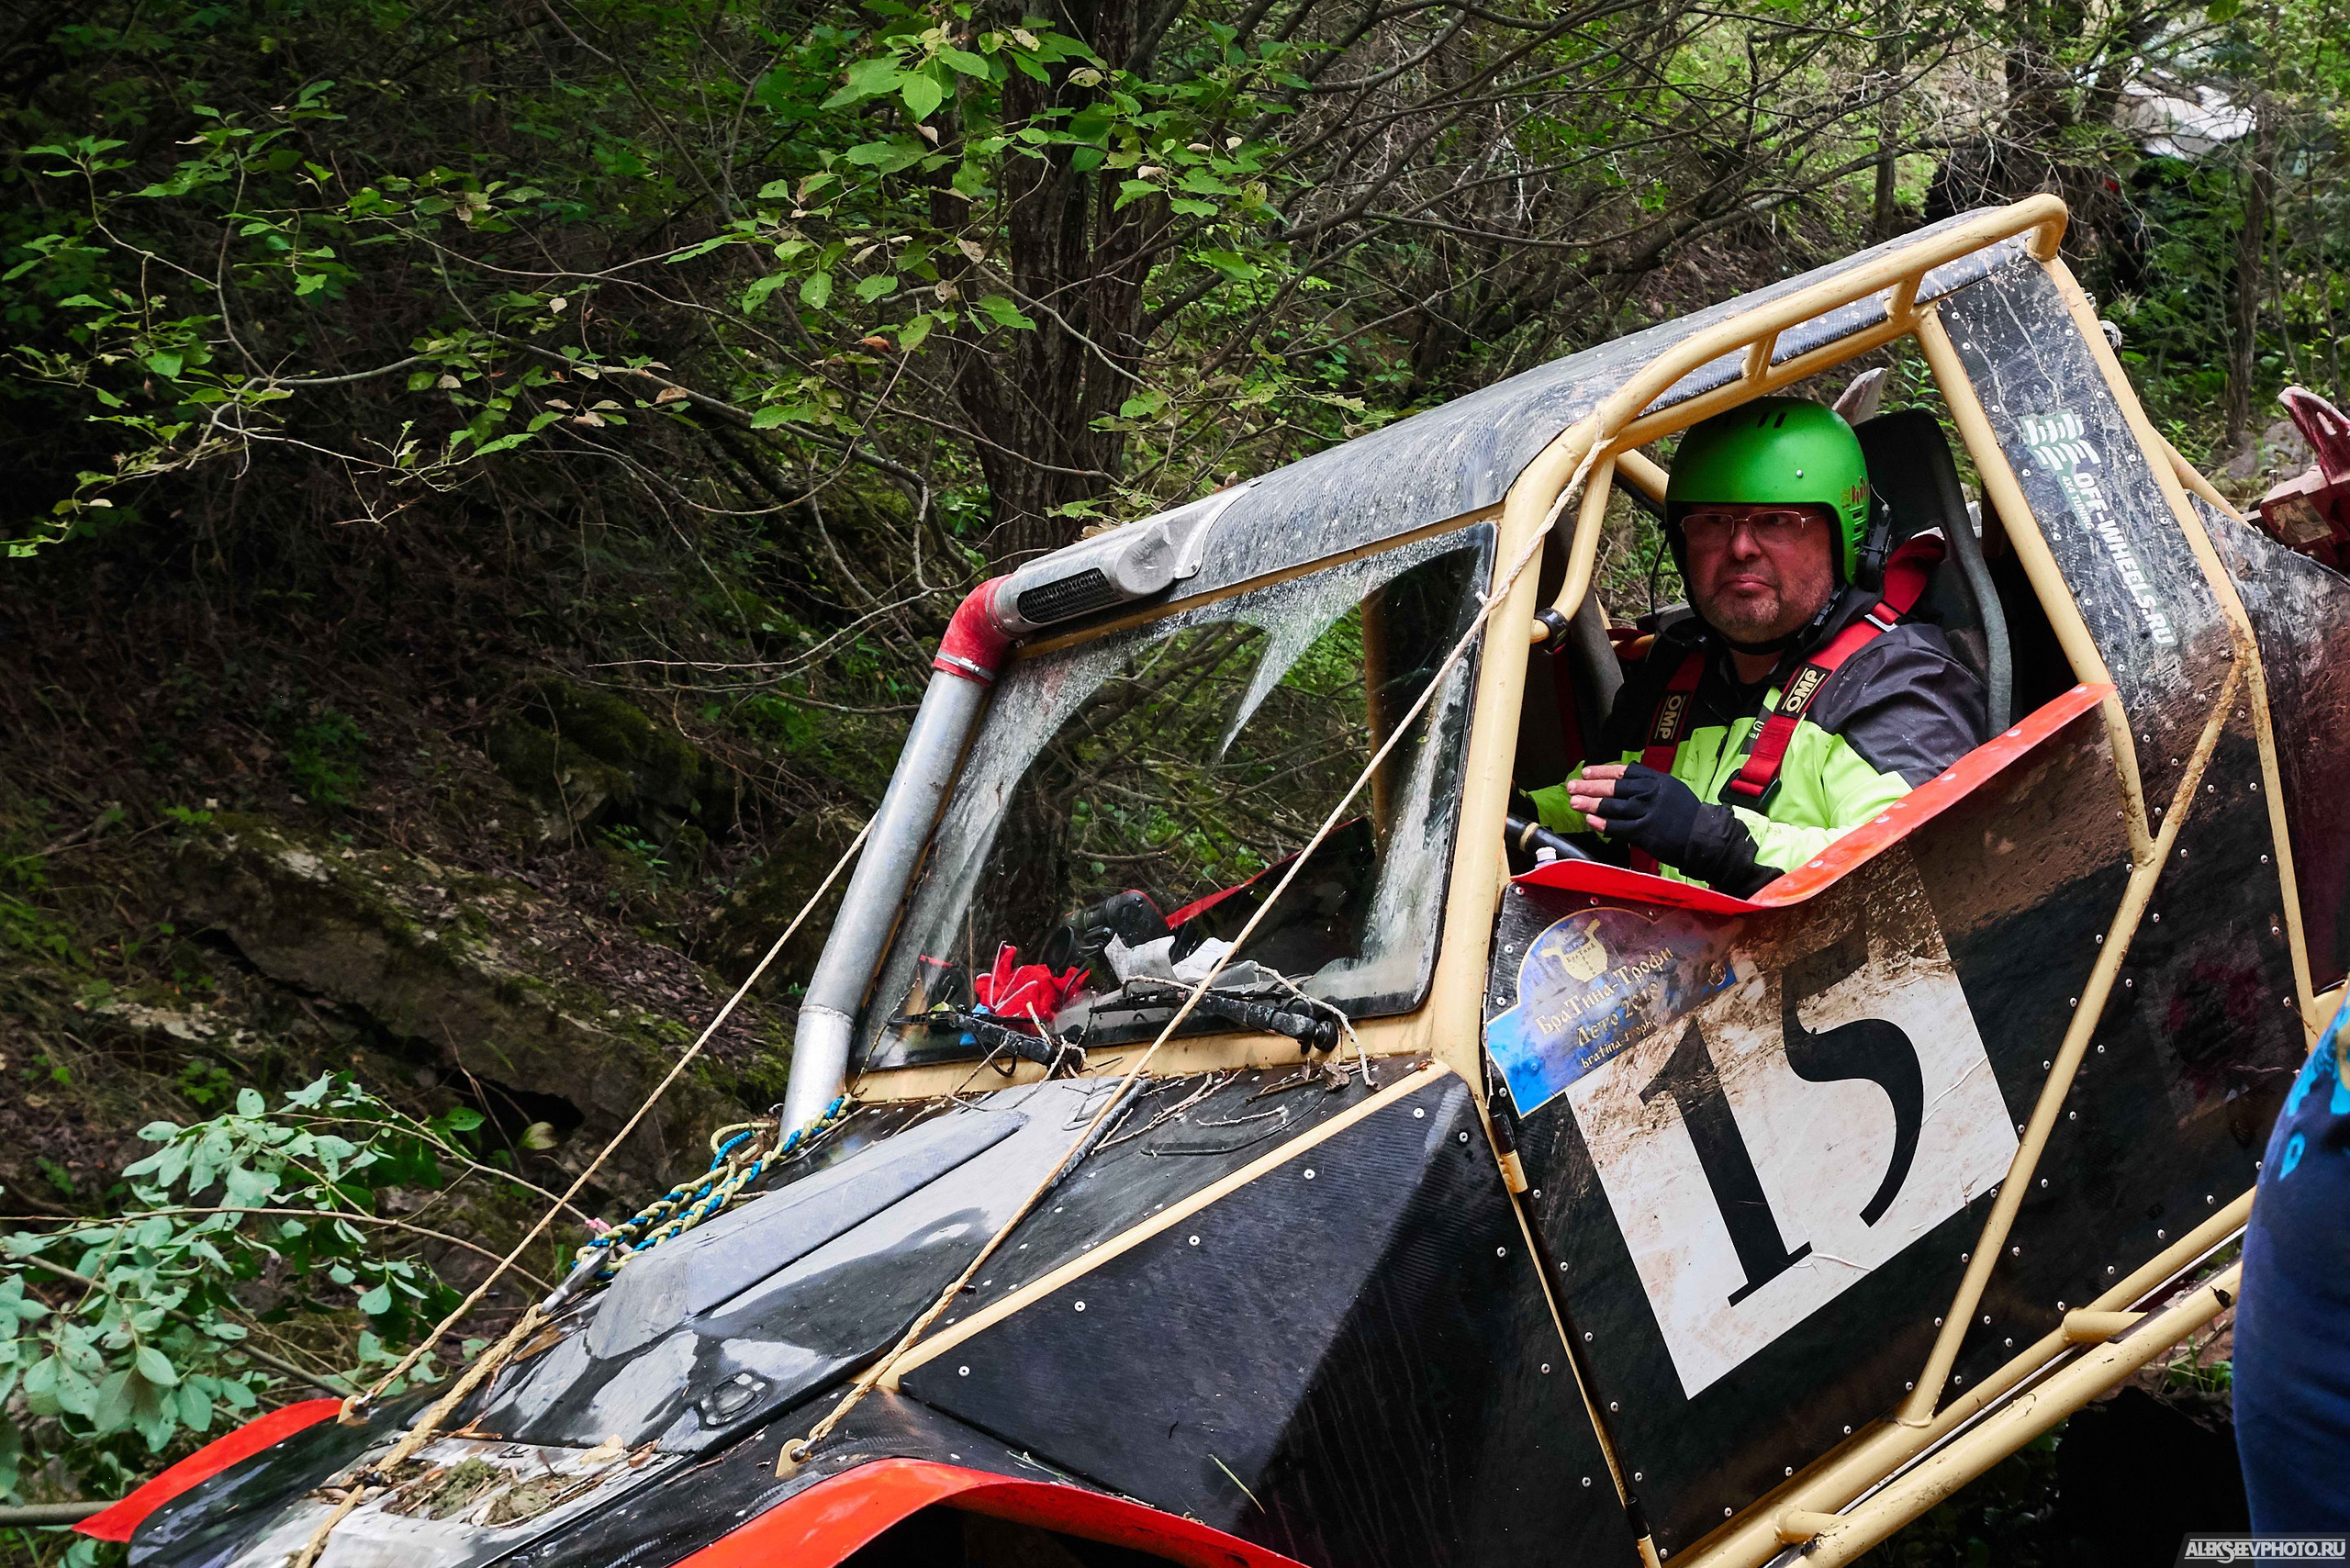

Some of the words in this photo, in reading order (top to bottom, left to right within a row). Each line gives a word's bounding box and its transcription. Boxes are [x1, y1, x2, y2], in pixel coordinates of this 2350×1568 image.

[2071, 494, 2095, 531] TUNING
[2073, 472, 2175, 644] OFF-WHEELS.RU
[1786, 669, 1818, 712] OMP
[1660, 695, 1683, 739] OMP
[1576, 1013, 1619, 1047] Лето
[1639, 907, 1924, 1308] 15
